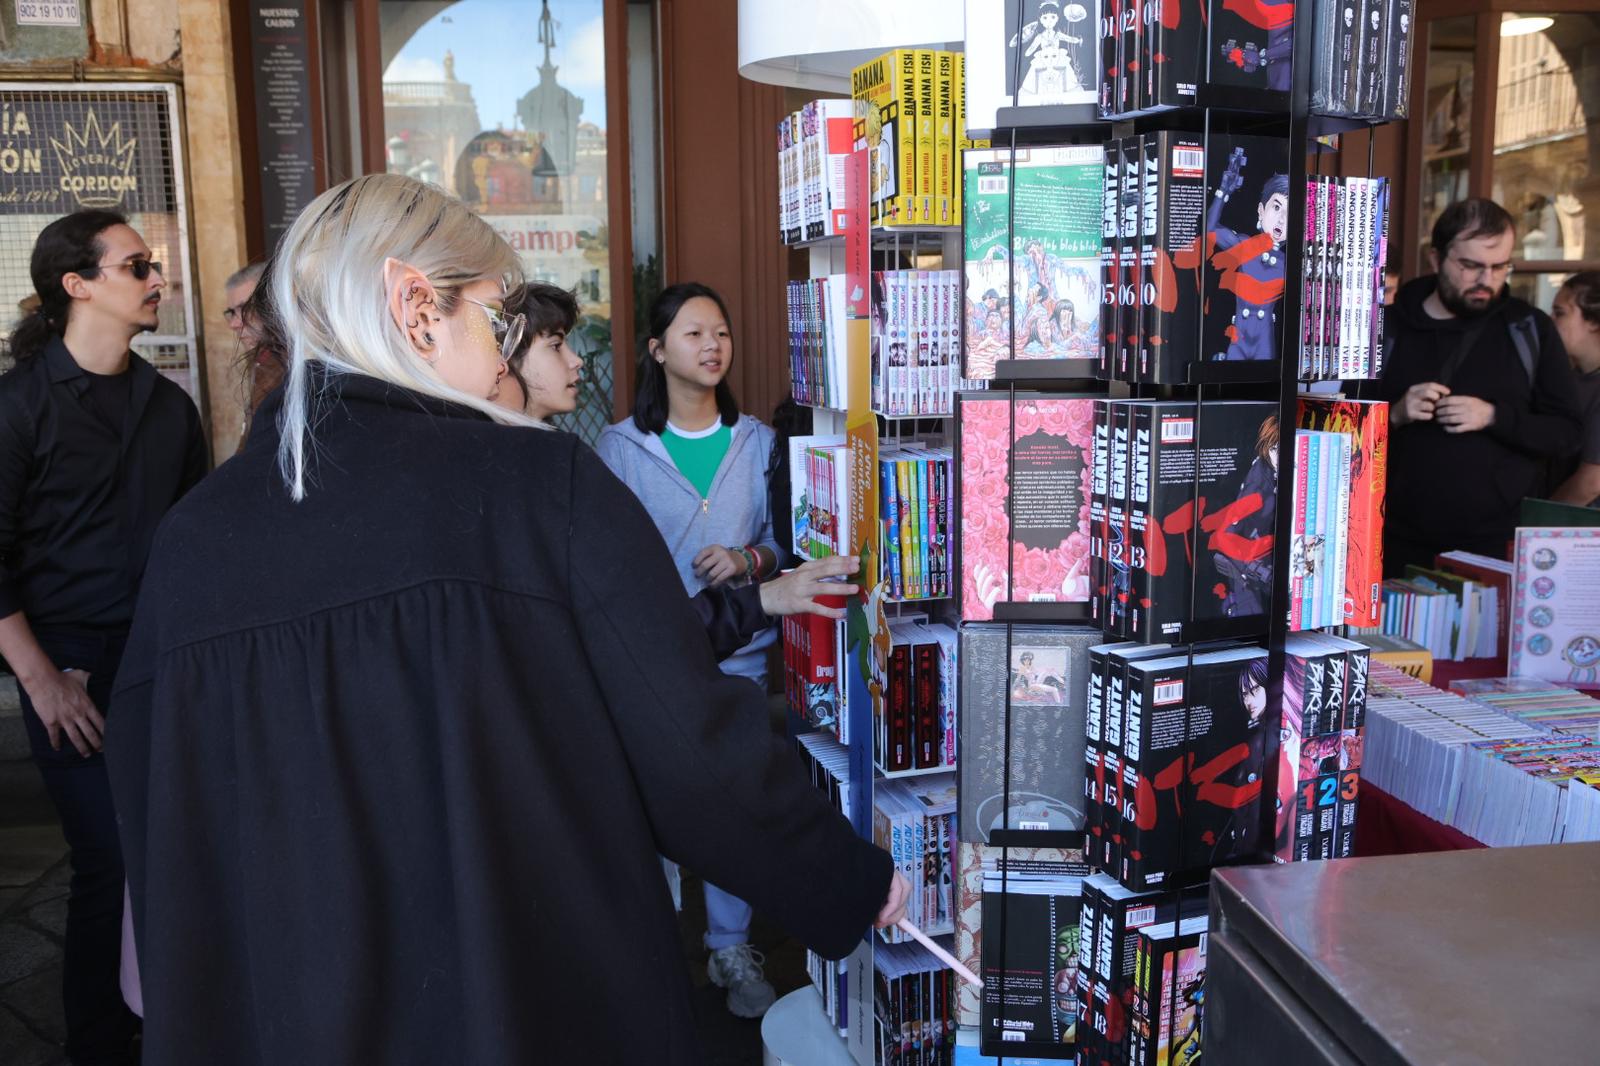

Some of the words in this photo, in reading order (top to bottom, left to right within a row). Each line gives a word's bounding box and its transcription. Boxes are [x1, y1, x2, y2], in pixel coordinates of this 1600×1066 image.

[20, 5, 37, 17] 902
[40, 7, 50, 18] 19
[53, 7, 63, 18] 10
[66, 7, 77, 18] 10
[264, 19, 295, 28] CALDOS
[1120, 9, 1136, 34] 02
[853, 60, 884, 95] BANANA
[904, 54, 914, 75] FISH
[921, 54, 931, 75] FISH
[940, 56, 950, 77] FISH
[904, 76, 914, 116] BANANA
[921, 77, 931, 116] BANANA
[940, 79, 950, 118] BANANA
[923, 121, 930, 135] 2
[66, 154, 126, 172] JOYERIAS
[60, 175, 137, 191] CORDON
[1104, 164, 1118, 237] GANTZ
[1125, 162, 1138, 237] GATZ
[1144, 158, 1158, 236] GANTZ
[1347, 184, 1357, 260] DANGANRONPA
[1358, 184, 1367, 260] DANGANRONPA
[1368, 185, 1378, 261] DANGANRONPA
[1307, 245, 1313, 256] 1
[1118, 283, 1135, 306] 06
[1140, 282, 1156, 306] 10
[1362, 347, 1370, 375] IVREA
[1375, 345, 1383, 372] IVREA
[1095, 424, 1107, 495] GANTZ
[1113, 427, 1127, 500] GANTZ
[1135, 429, 1149, 503] GANTZ
[857, 438, 866, 522] aventuras
[1300, 440, 1308, 519] BAKEMONOGATARI
[1343, 487, 1349, 498] de
[892, 537, 898, 545] 2
[937, 533, 945, 545] 7
[1091, 536, 1103, 558] 11
[1108, 541, 1123, 564] 12
[1131, 546, 1145, 569] 13
[1089, 672, 1102, 741] GANTZ
[1109, 676, 1122, 747] GANTZ
[1128, 689, 1142, 762] GANTZ
[1085, 777, 1097, 800] 14
[1105, 783, 1117, 806] 15
[1302, 782, 1316, 810] 1
[1318, 777, 1337, 806] 2
[1341, 773, 1358, 800] 3
[1123, 798, 1136, 822] 16
[1342, 831, 1350, 857] IVREA
[905, 864, 912, 872] 6
[916, 862, 922, 871] 5
[1081, 903, 1094, 970] GANTZ
[1101, 912, 1113, 981] GANTZ
[1094, 1010, 1107, 1036] 18
